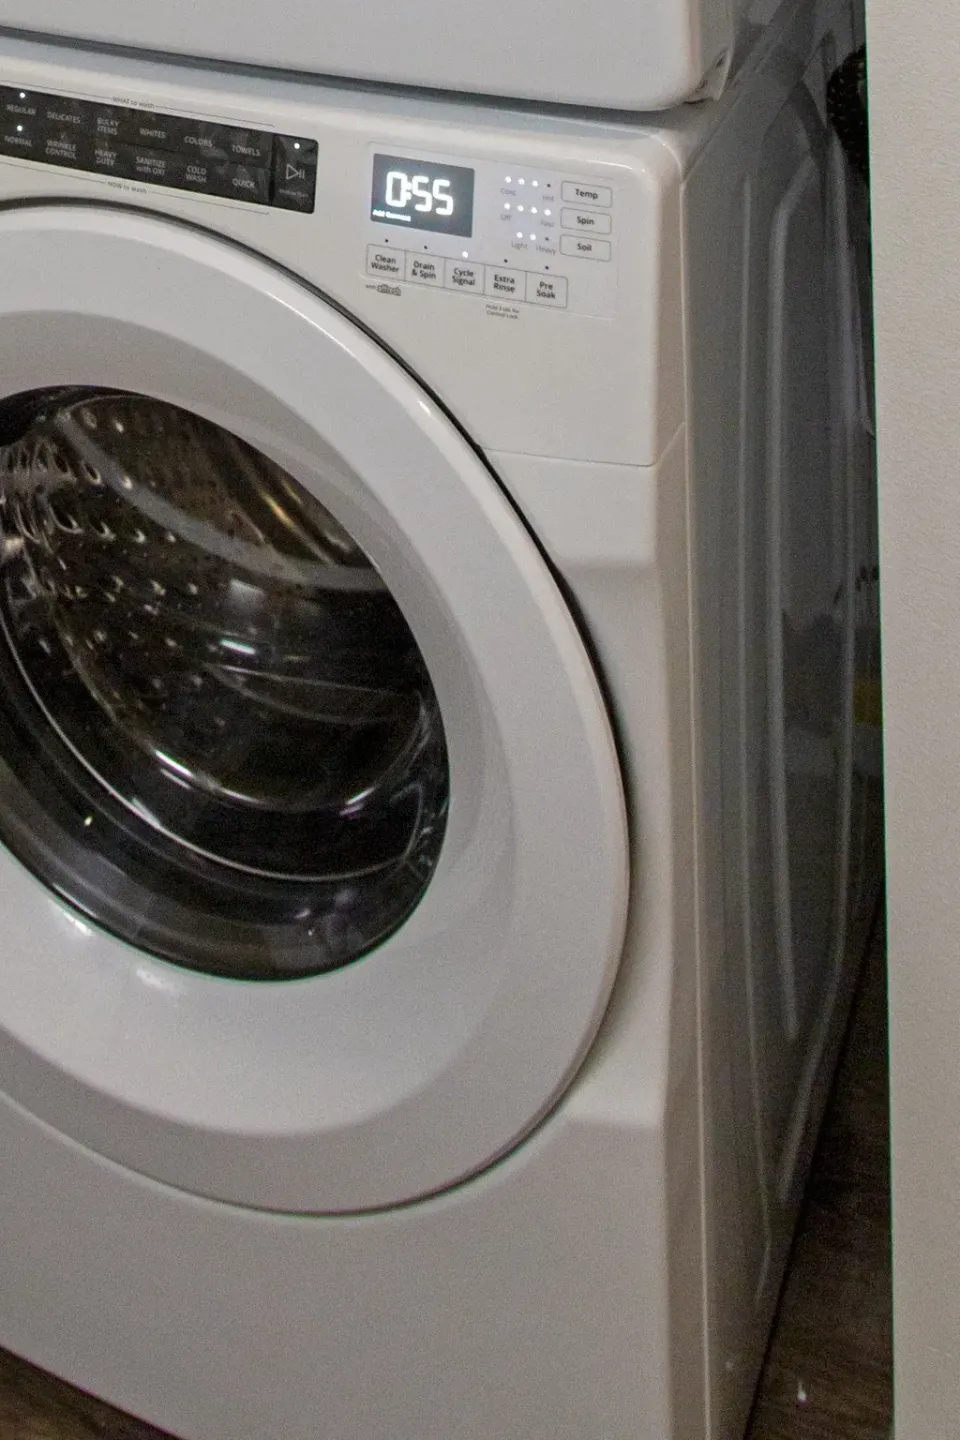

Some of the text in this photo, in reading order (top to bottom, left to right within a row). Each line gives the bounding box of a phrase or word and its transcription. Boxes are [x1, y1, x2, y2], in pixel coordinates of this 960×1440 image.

[6, 104, 36, 115] REGULAR
[47, 111, 81, 124] DELICATES
[96, 117, 120, 127] BULKY
[97, 125, 118, 135] ITEMS
[140, 129, 166, 139] WHITES
[4, 135, 32, 147] NORMAL
[184, 136, 213, 147] COLORS
[45, 148, 76, 160] CONTROL
[94, 149, 118, 159] HEAVY
[232, 145, 261, 157] TOWELS
[136, 156, 166, 169] SANITIZE
[187, 166, 207, 175] COLD
[186, 173, 207, 183] WASH
[232, 177, 255, 189] QUICK
[385, 171, 454, 216] 0:55
[575, 188, 599, 200] Temp
[577, 216, 595, 226] Spin
[577, 242, 592, 252] Soil
[375, 254, 396, 264] Clean
[371, 262, 399, 273] Washer
[413, 261, 435, 271] Drain
[419, 270, 436, 280] Spin
[454, 268, 474, 278] Cycle
[452, 275, 476, 286] Signal
[494, 274, 515, 284] Extra
[493, 282, 515, 293] Rinse
[540, 281, 553, 290] Pre
[536, 289, 556, 299] Soak
